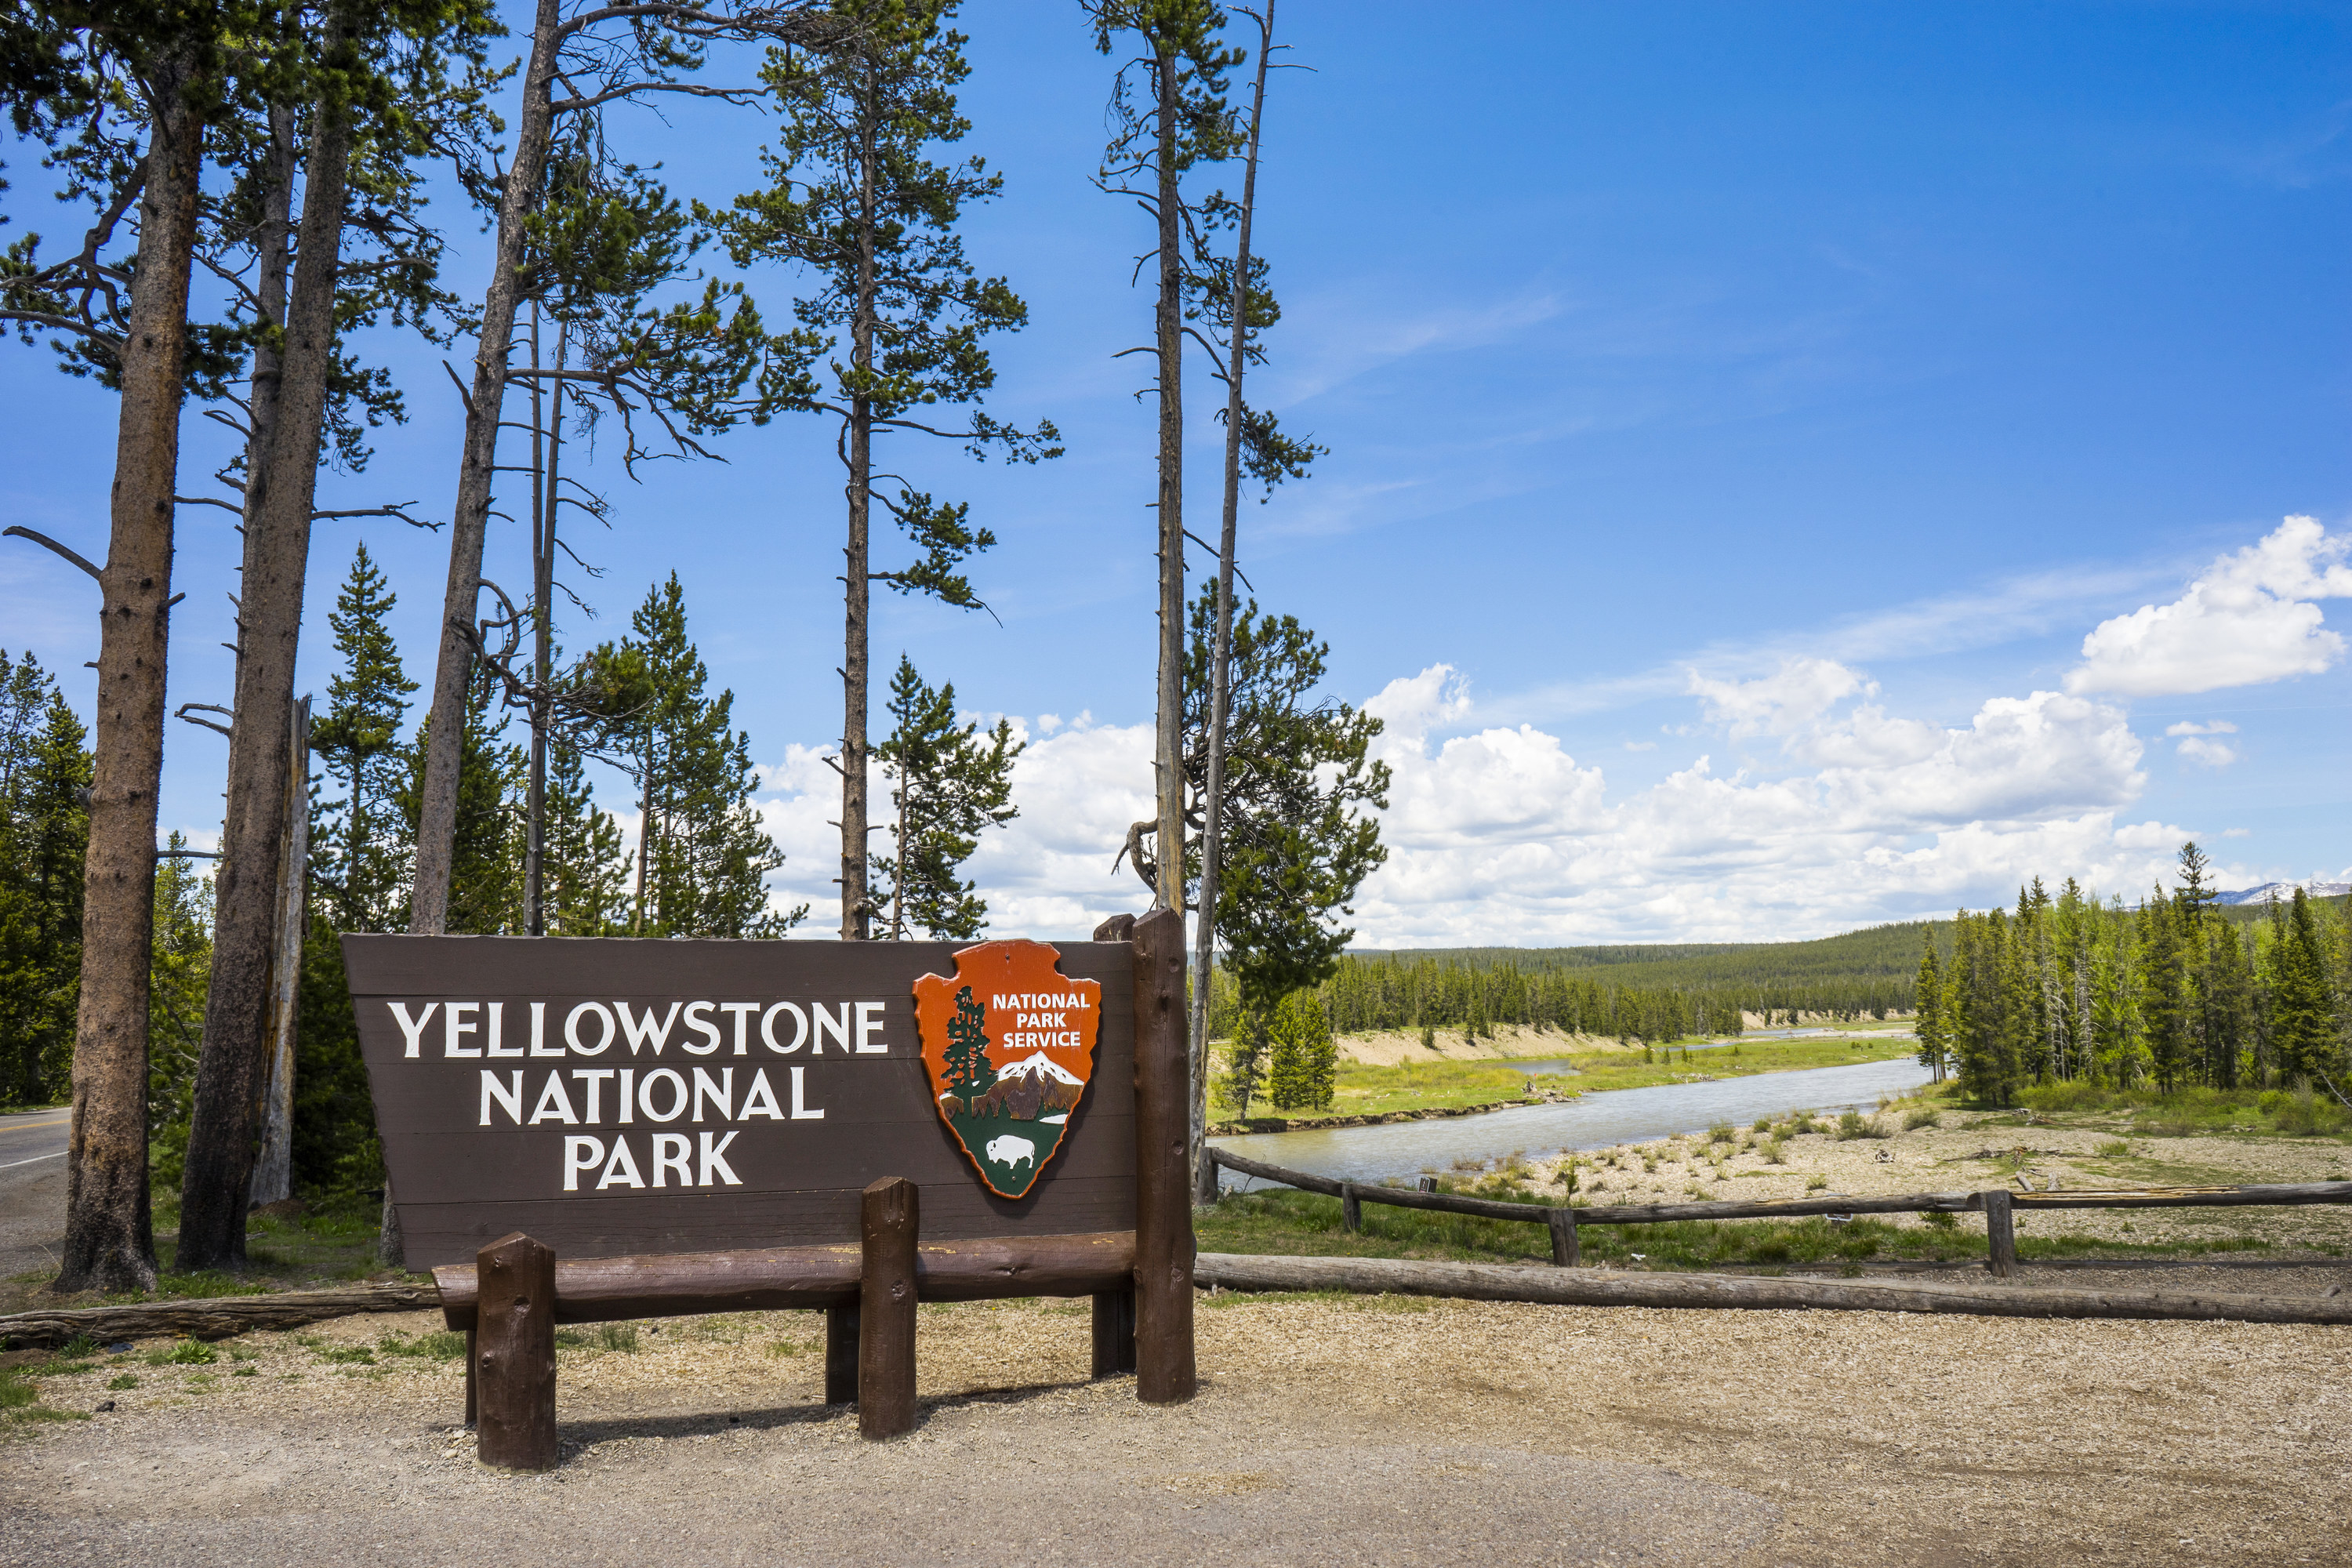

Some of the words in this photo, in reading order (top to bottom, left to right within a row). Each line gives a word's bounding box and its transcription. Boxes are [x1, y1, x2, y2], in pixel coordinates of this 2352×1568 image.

[993, 993, 1091, 1010] NATIONAL
[387, 1000, 888, 1058] YELLOWSTONE
[1016, 1012, 1067, 1029] PARK
[1003, 1031, 1081, 1048] SERVICE
[478, 1066, 825, 1126] NATIONAL
[563, 1131, 743, 1191] PARK
